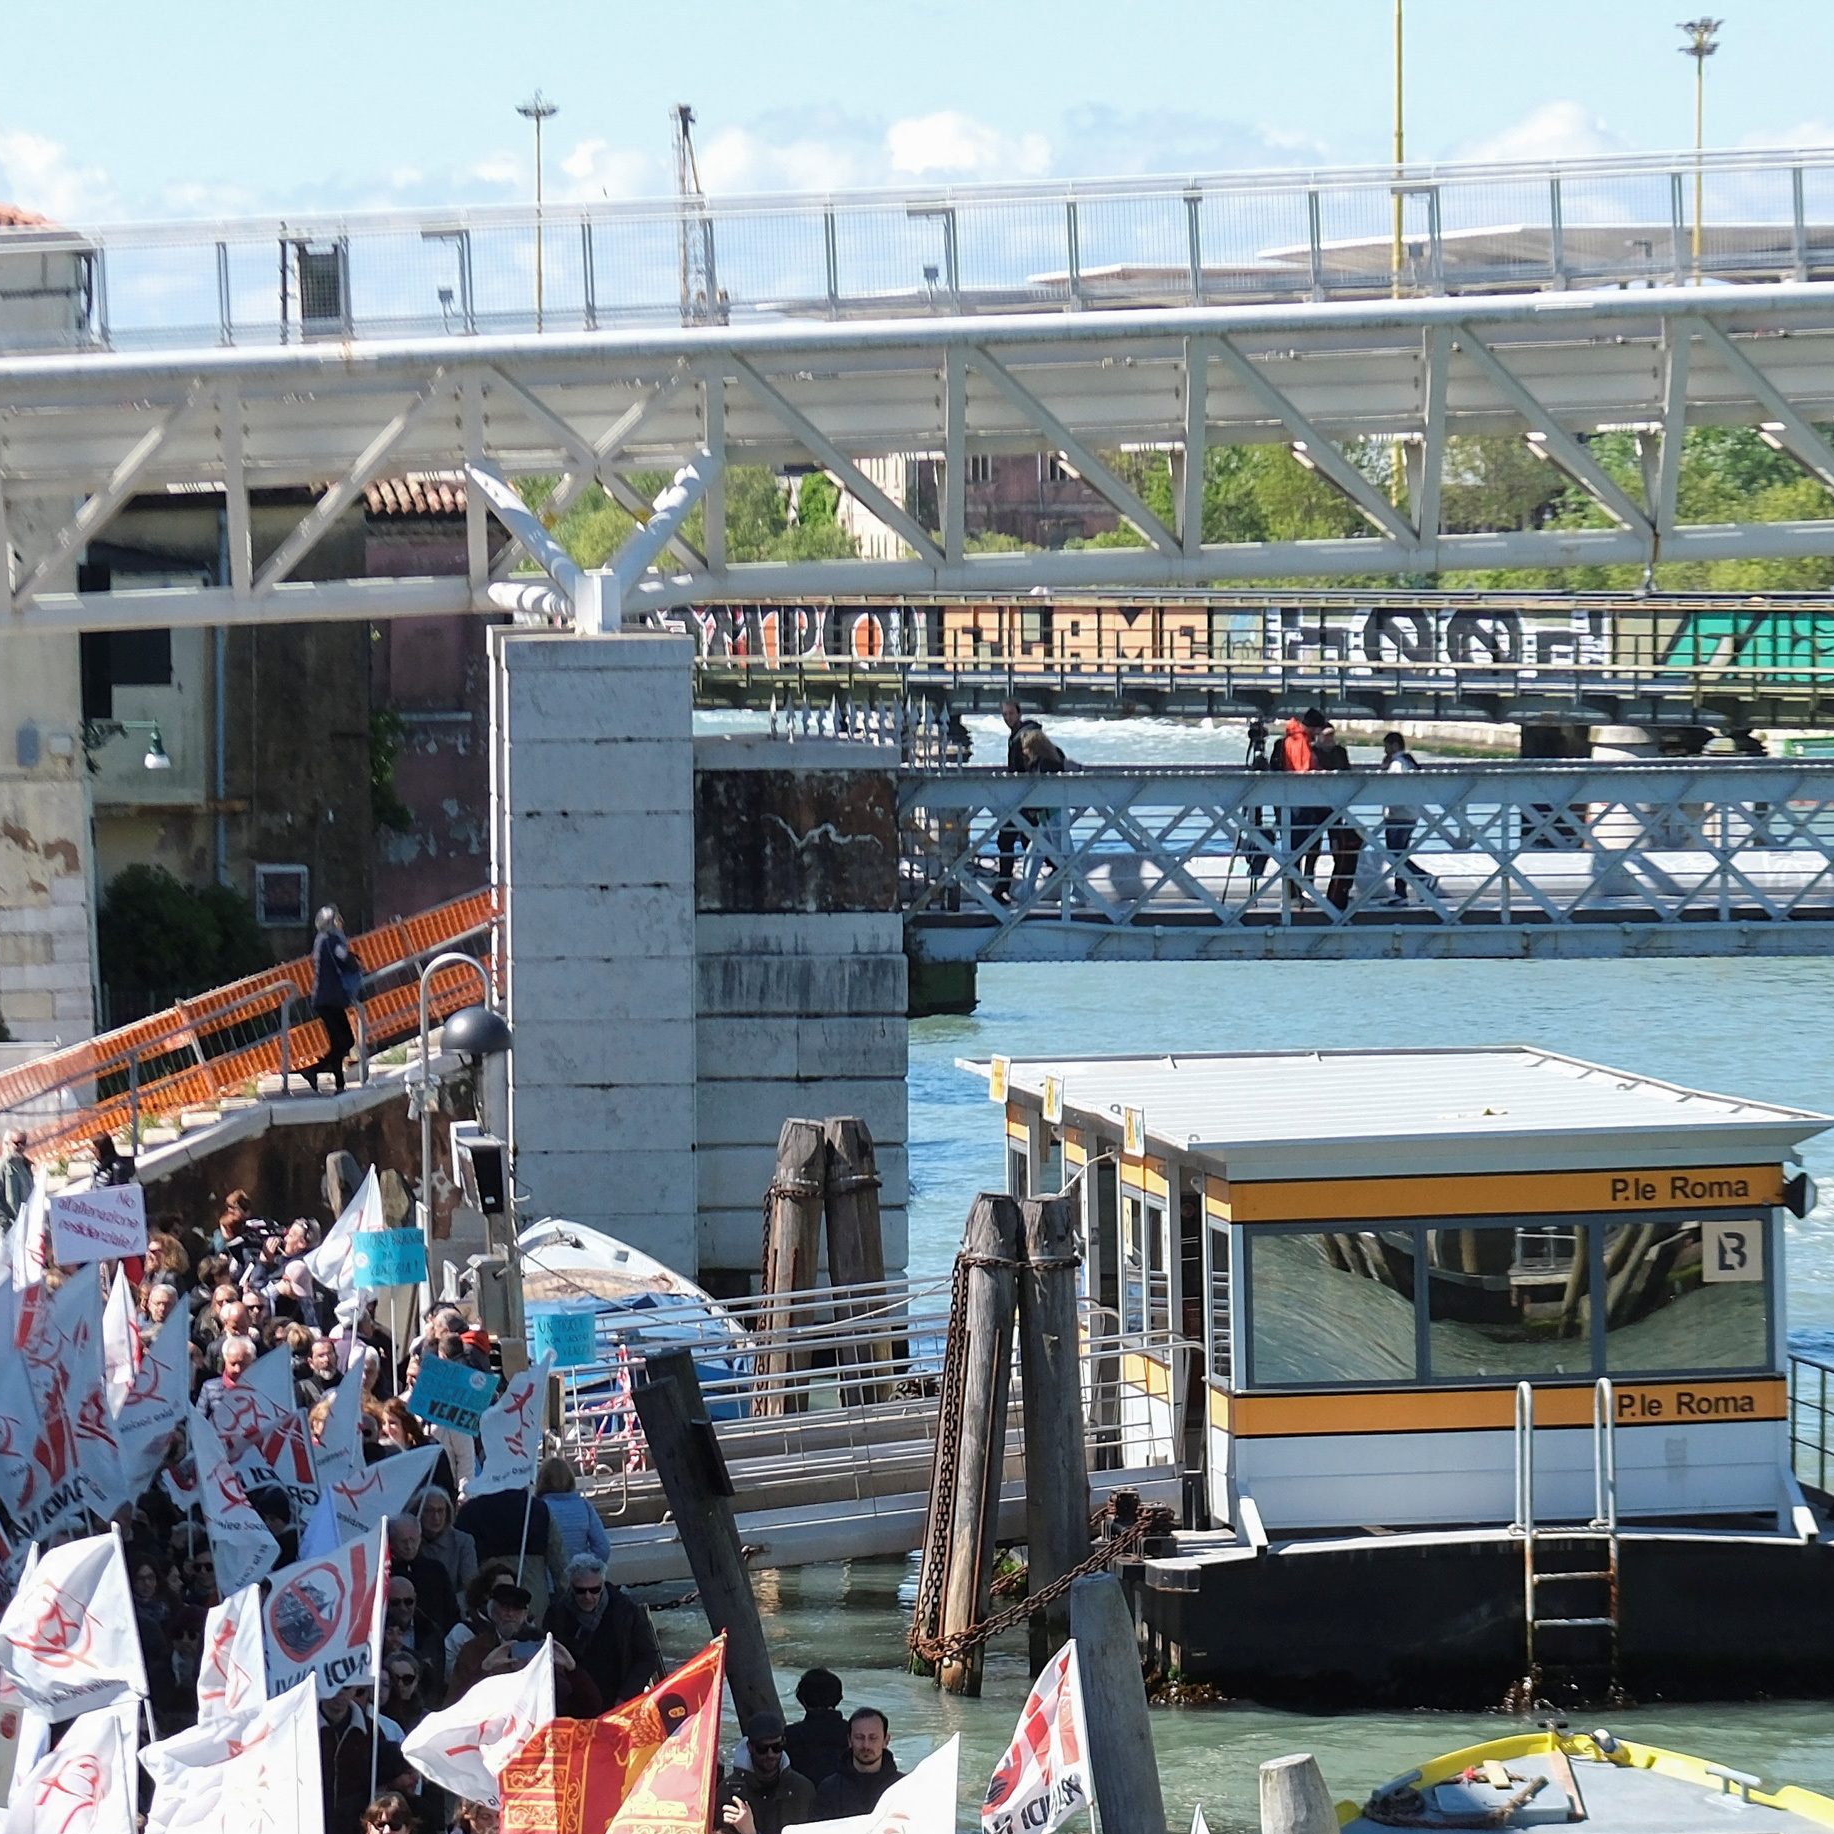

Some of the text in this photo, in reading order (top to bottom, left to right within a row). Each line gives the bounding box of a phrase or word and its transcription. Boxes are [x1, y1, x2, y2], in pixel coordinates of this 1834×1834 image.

[1611, 1175, 1750, 1202] P.le Roma
[1717, 1231, 1748, 1271] B
[1617, 1391, 1755, 1418] P.le Roma
